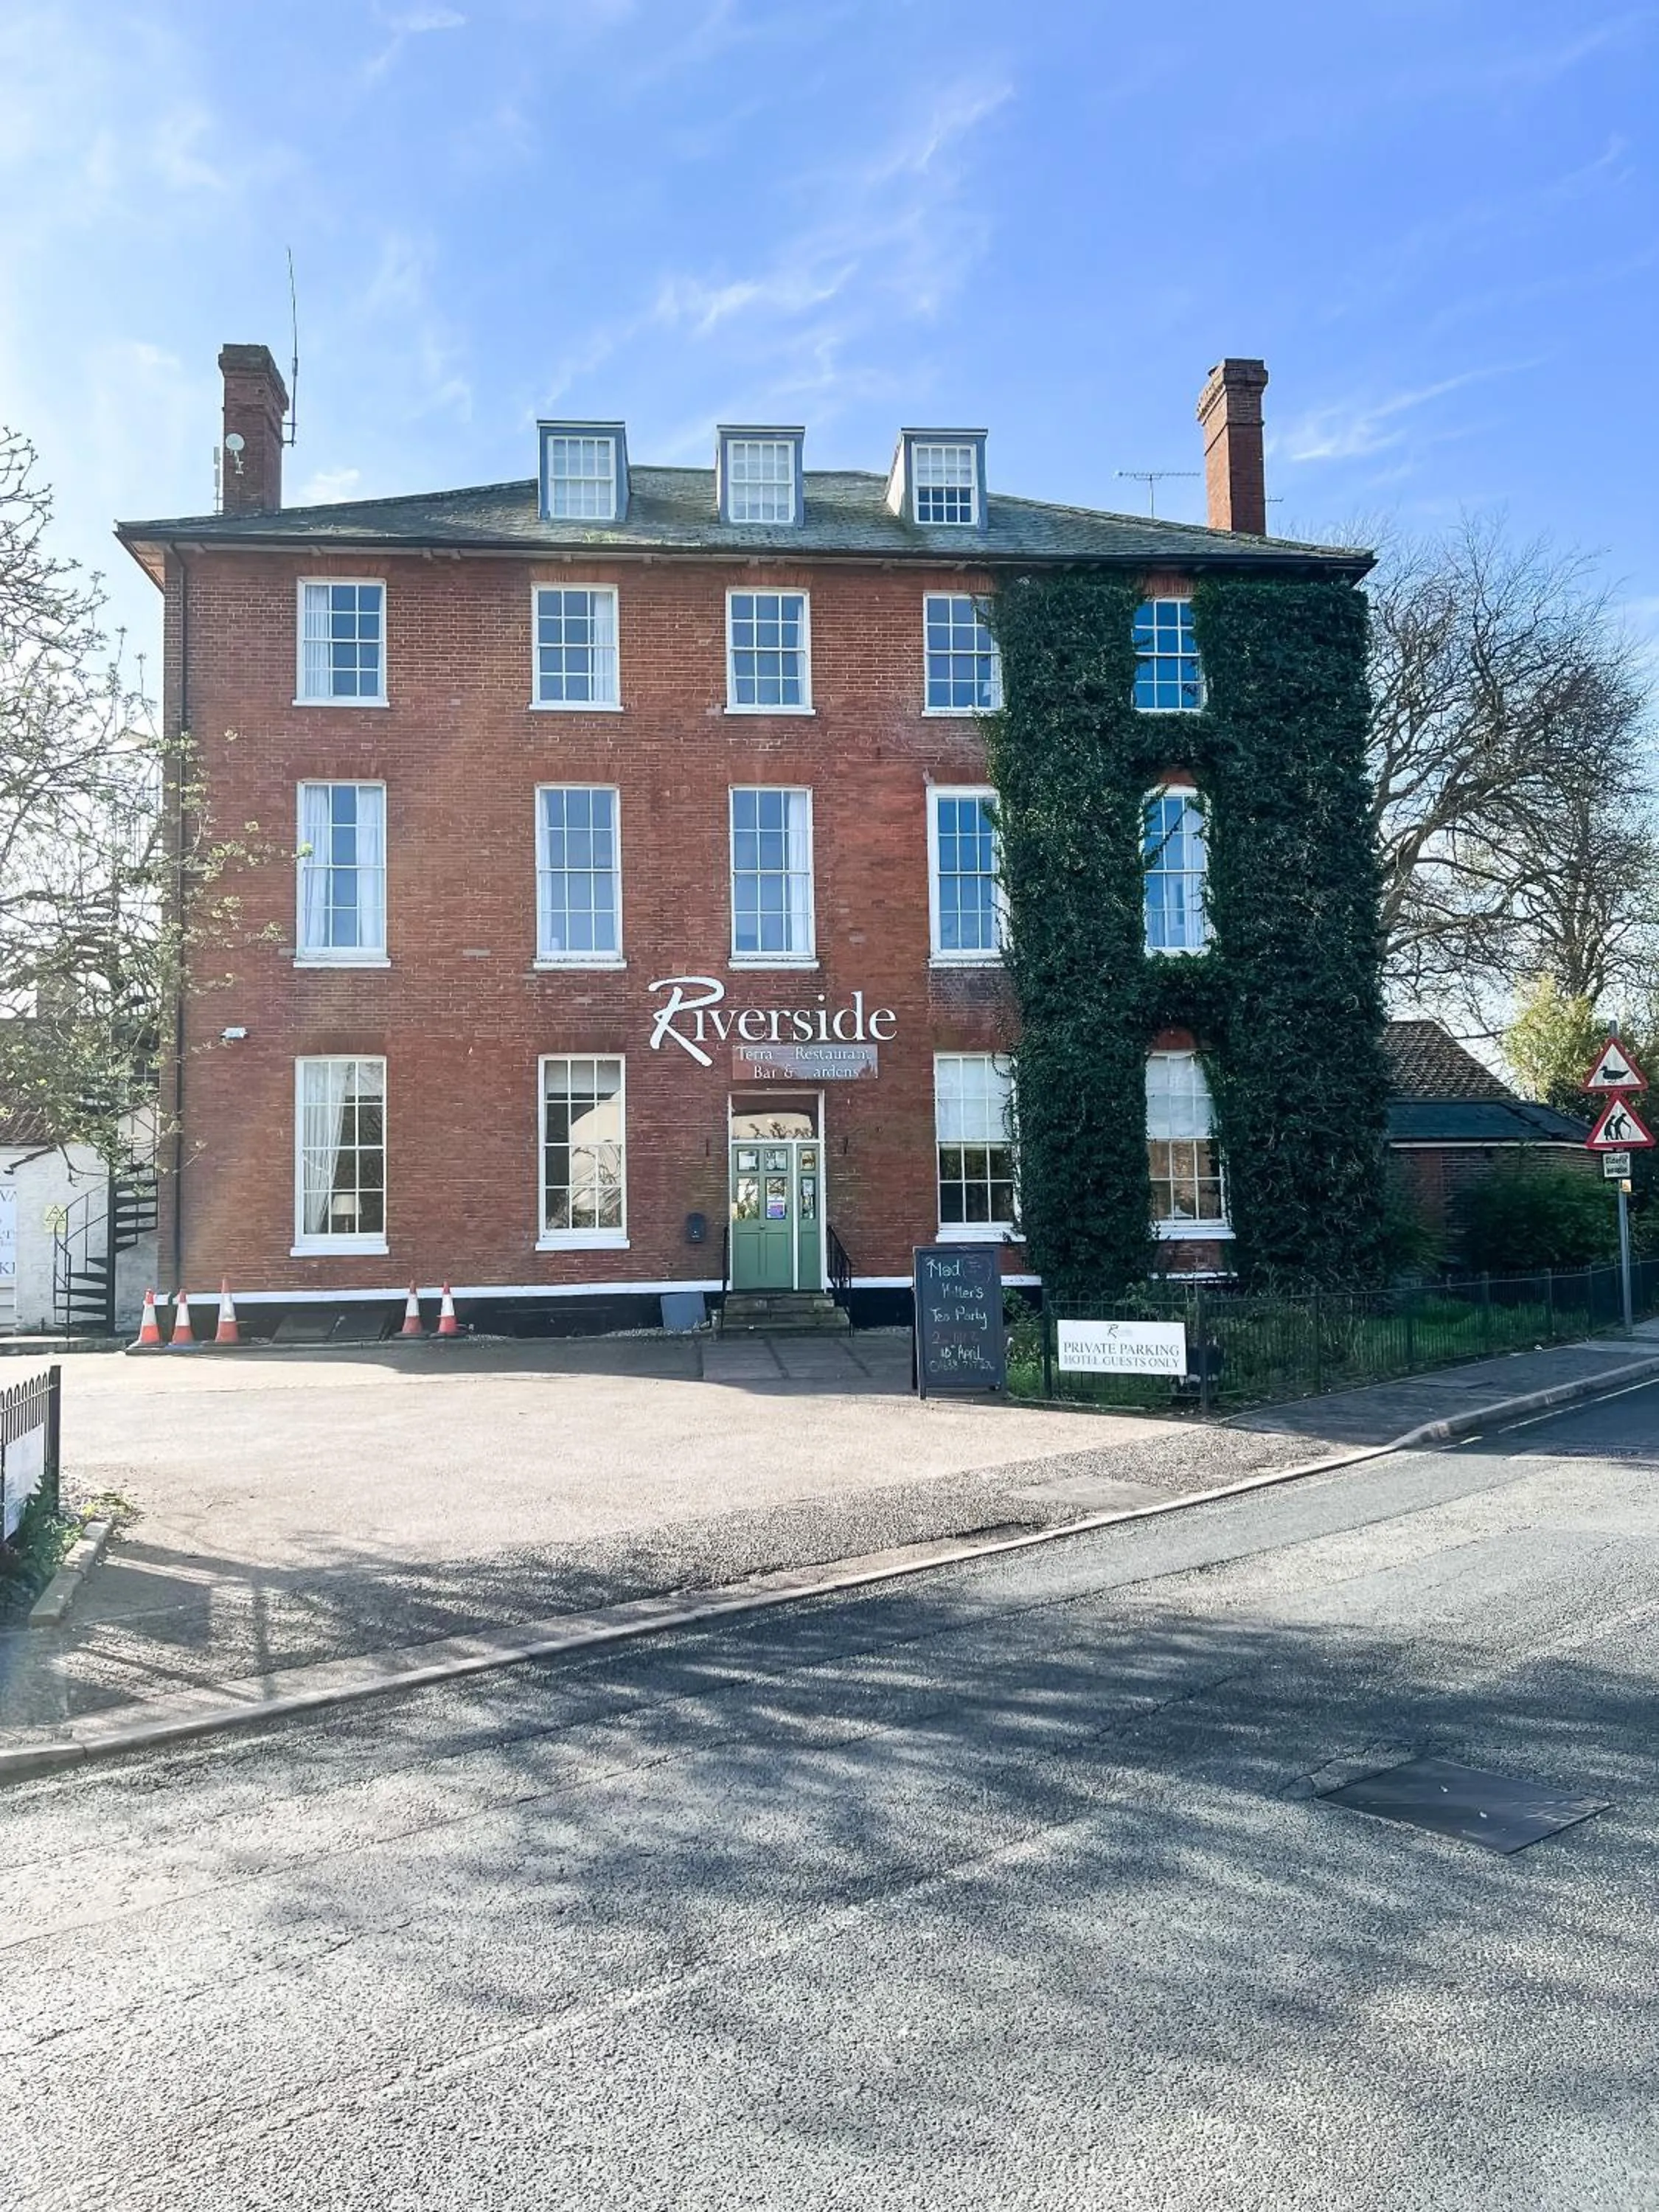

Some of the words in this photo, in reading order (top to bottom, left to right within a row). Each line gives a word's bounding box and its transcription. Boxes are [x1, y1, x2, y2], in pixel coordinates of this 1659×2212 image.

[648, 975, 897, 1067] Riverside
[796, 1046, 872, 1060] Restaurant
[754, 1065, 776, 1079] Bar
[926, 1258, 961, 1278] Mad
[956, 1306, 987, 1330] Party
[1063, 1342, 1117, 1354] PRIVATE
[1119, 1344, 1180, 1357] PARKING
[1064, 1355, 1097, 1365] HOTEL
[1102, 1357, 1147, 1367] GUESTS
[1148, 1358, 1179, 1368] ONLY
